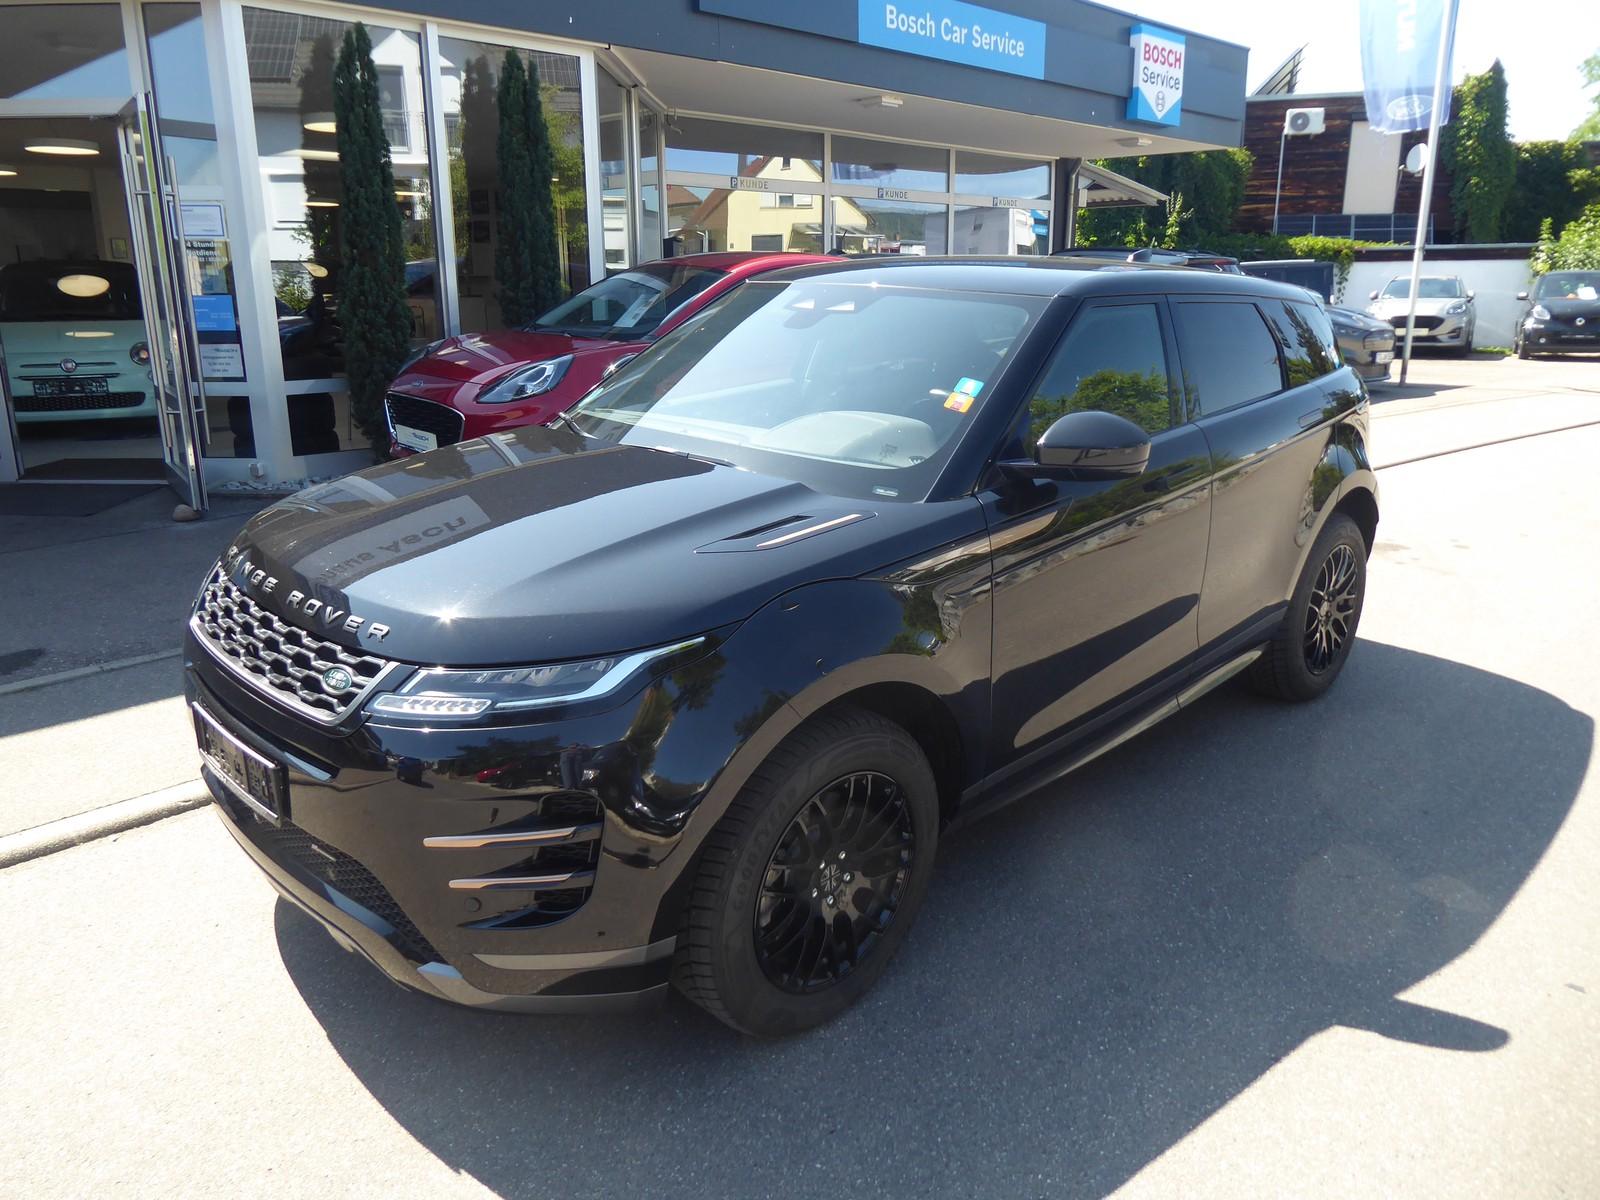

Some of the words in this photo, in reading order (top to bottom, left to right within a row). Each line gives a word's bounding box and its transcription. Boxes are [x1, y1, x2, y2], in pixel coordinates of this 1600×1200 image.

[885, 4, 936, 38] Bosch
[940, 18, 968, 46] Car
[971, 25, 1025, 58] Service
[1143, 42, 1182, 70] BOSCH
[1142, 66, 1181, 91] Service
[740, 179, 769, 190] KUNDE
[885, 190, 908, 199] KUNDE
[227, 545, 279, 593] RANGE
[286, 590, 391, 643] ROVER
